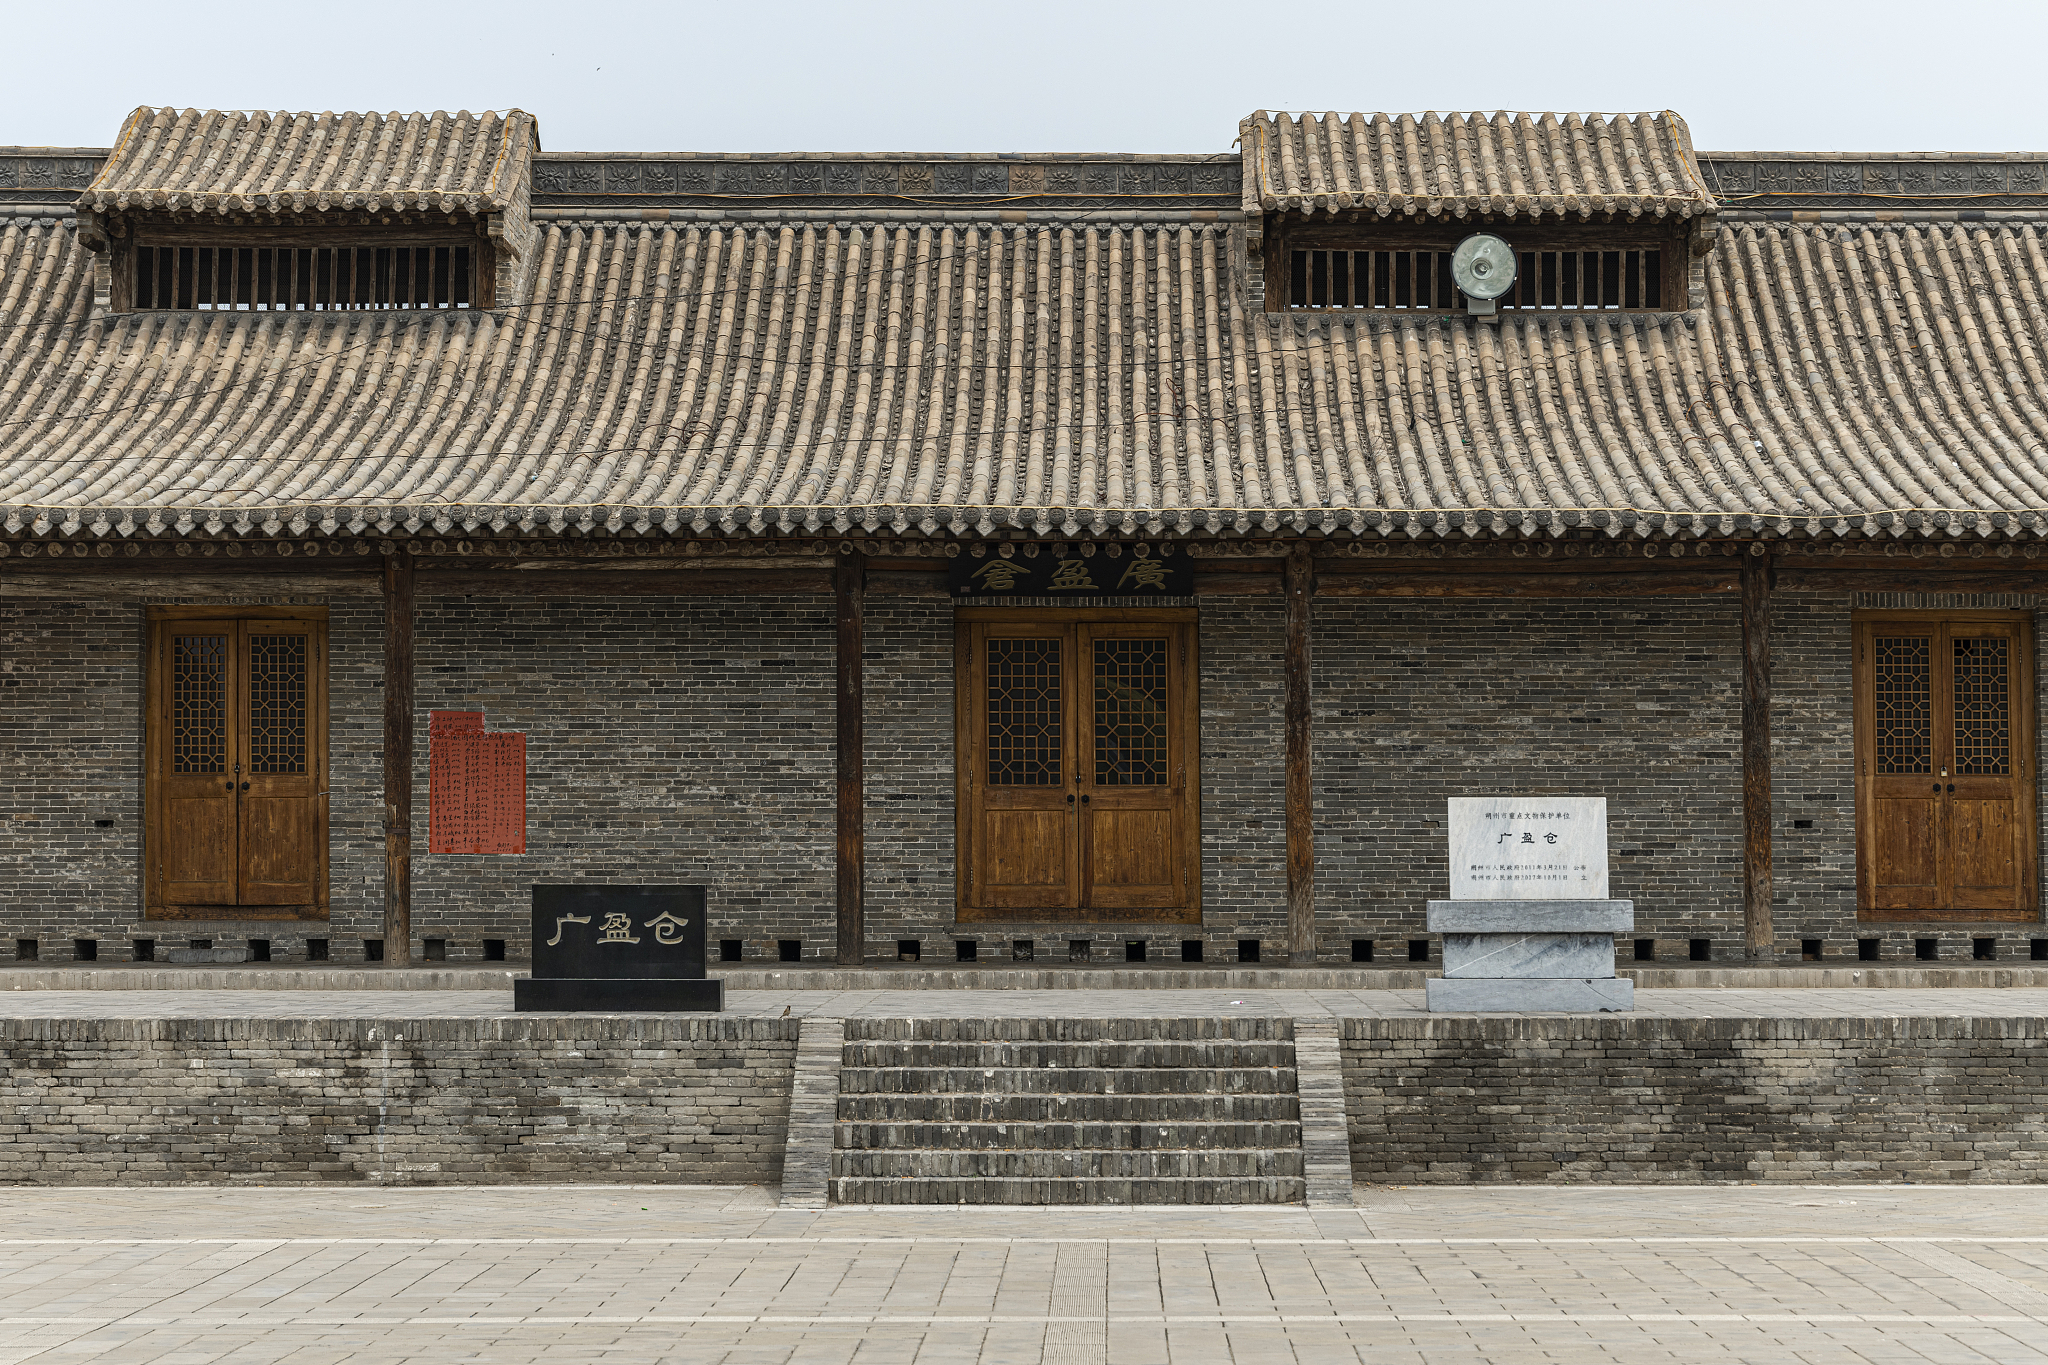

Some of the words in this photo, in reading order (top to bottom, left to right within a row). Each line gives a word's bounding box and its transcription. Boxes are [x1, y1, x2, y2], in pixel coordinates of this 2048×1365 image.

[1484, 811, 1571, 820] 朔州市重点文物保护单位
[1497, 831, 1558, 845] 广盈仓
[546, 910, 689, 946] 广盈仓
